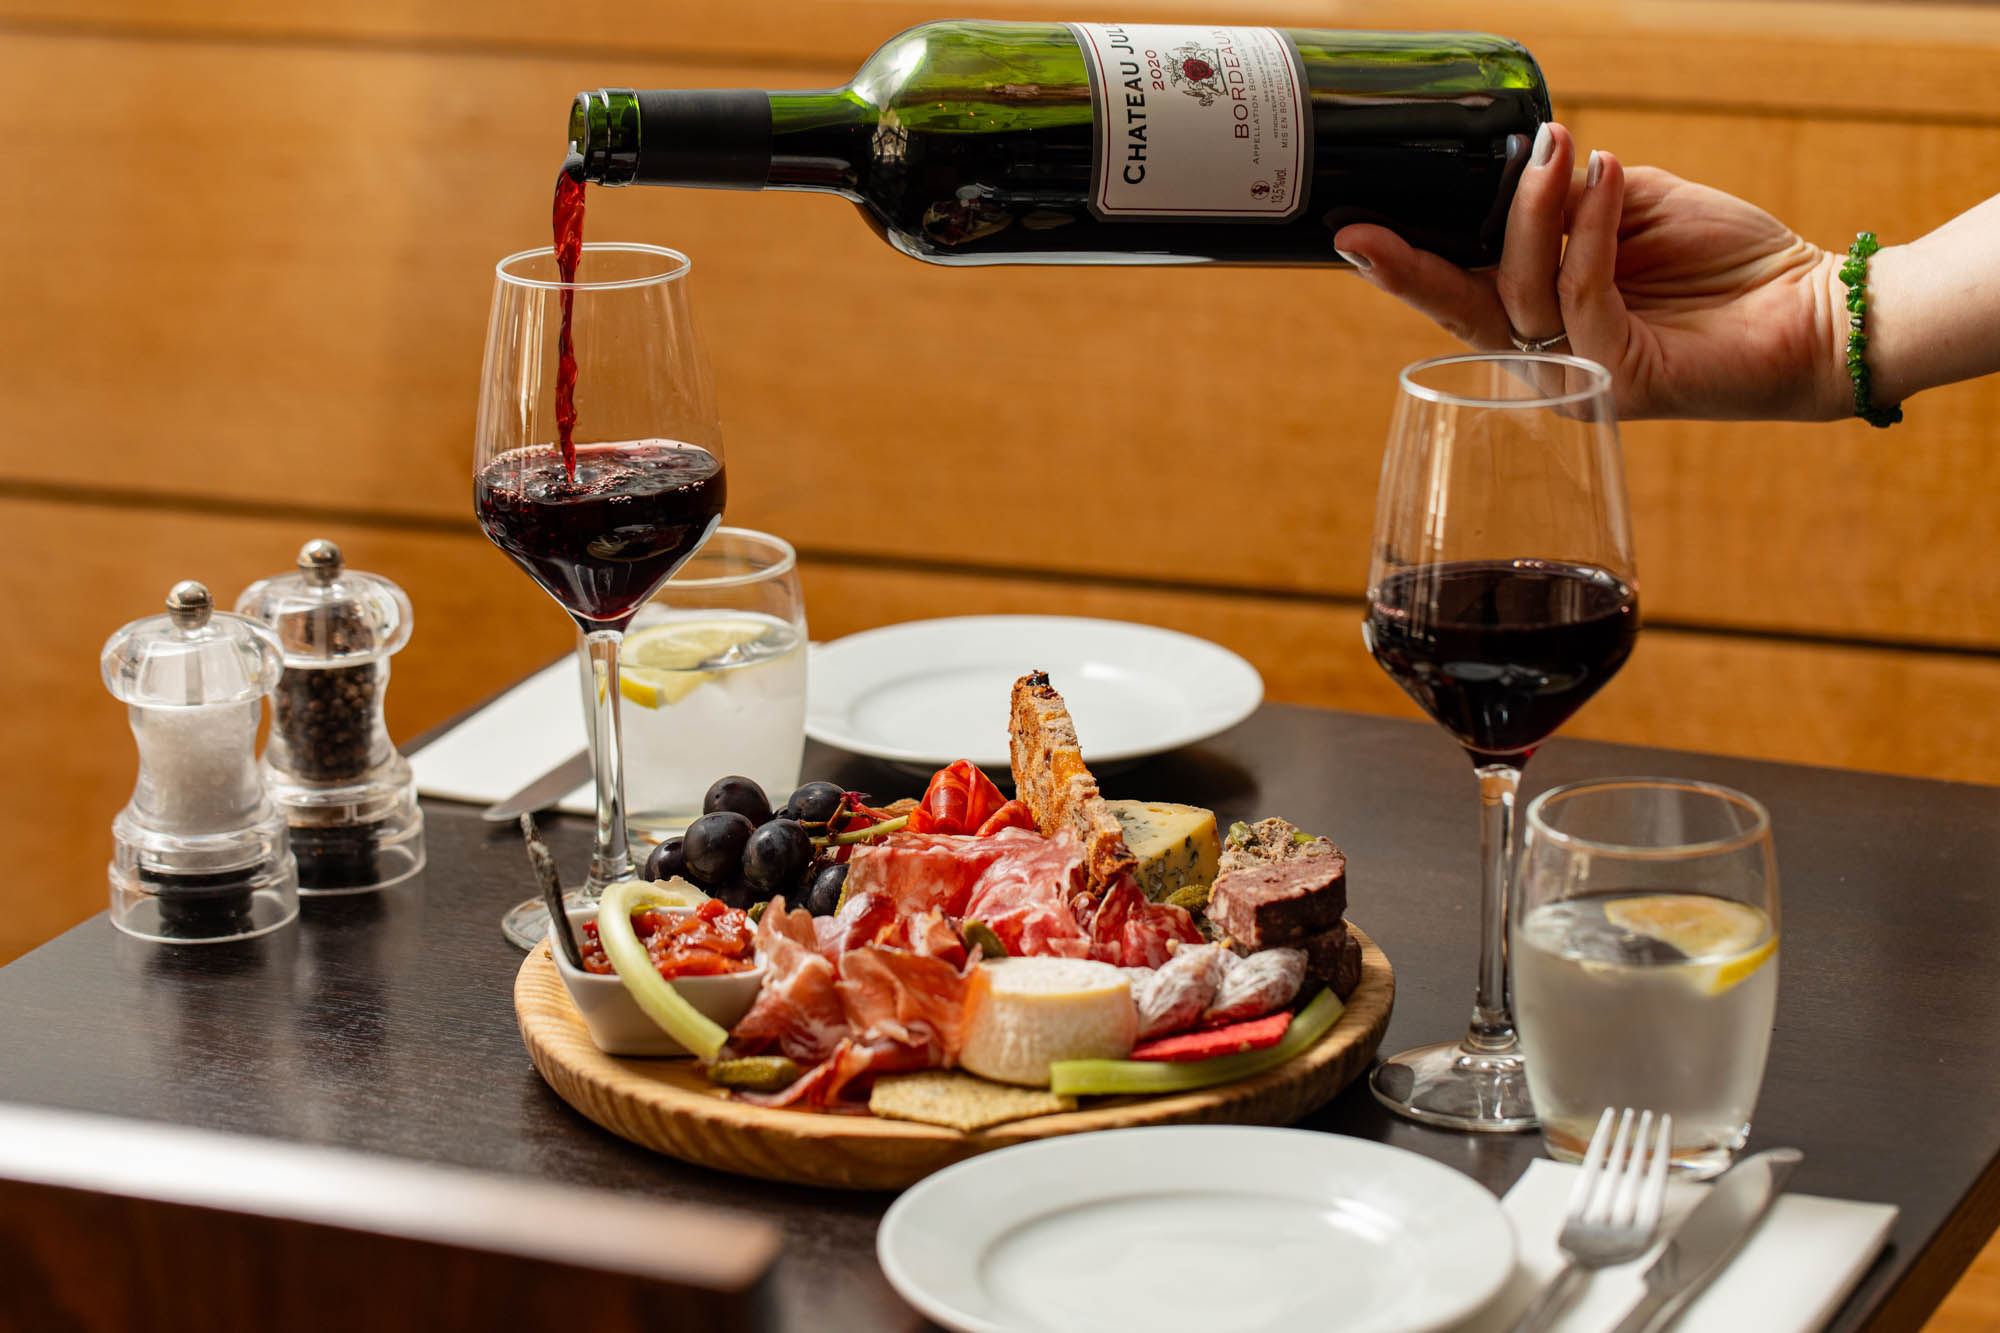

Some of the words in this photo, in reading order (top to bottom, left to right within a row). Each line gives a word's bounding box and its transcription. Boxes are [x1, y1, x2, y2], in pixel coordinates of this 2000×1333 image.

[1144, 49, 1165, 91] 2020
[1274, 69, 1287, 113] BOUTEILLE
[1120, 61, 1147, 185] CHATEAU
[1251, 95, 1260, 165] APPELLATION
[1280, 117, 1288, 129] EN
